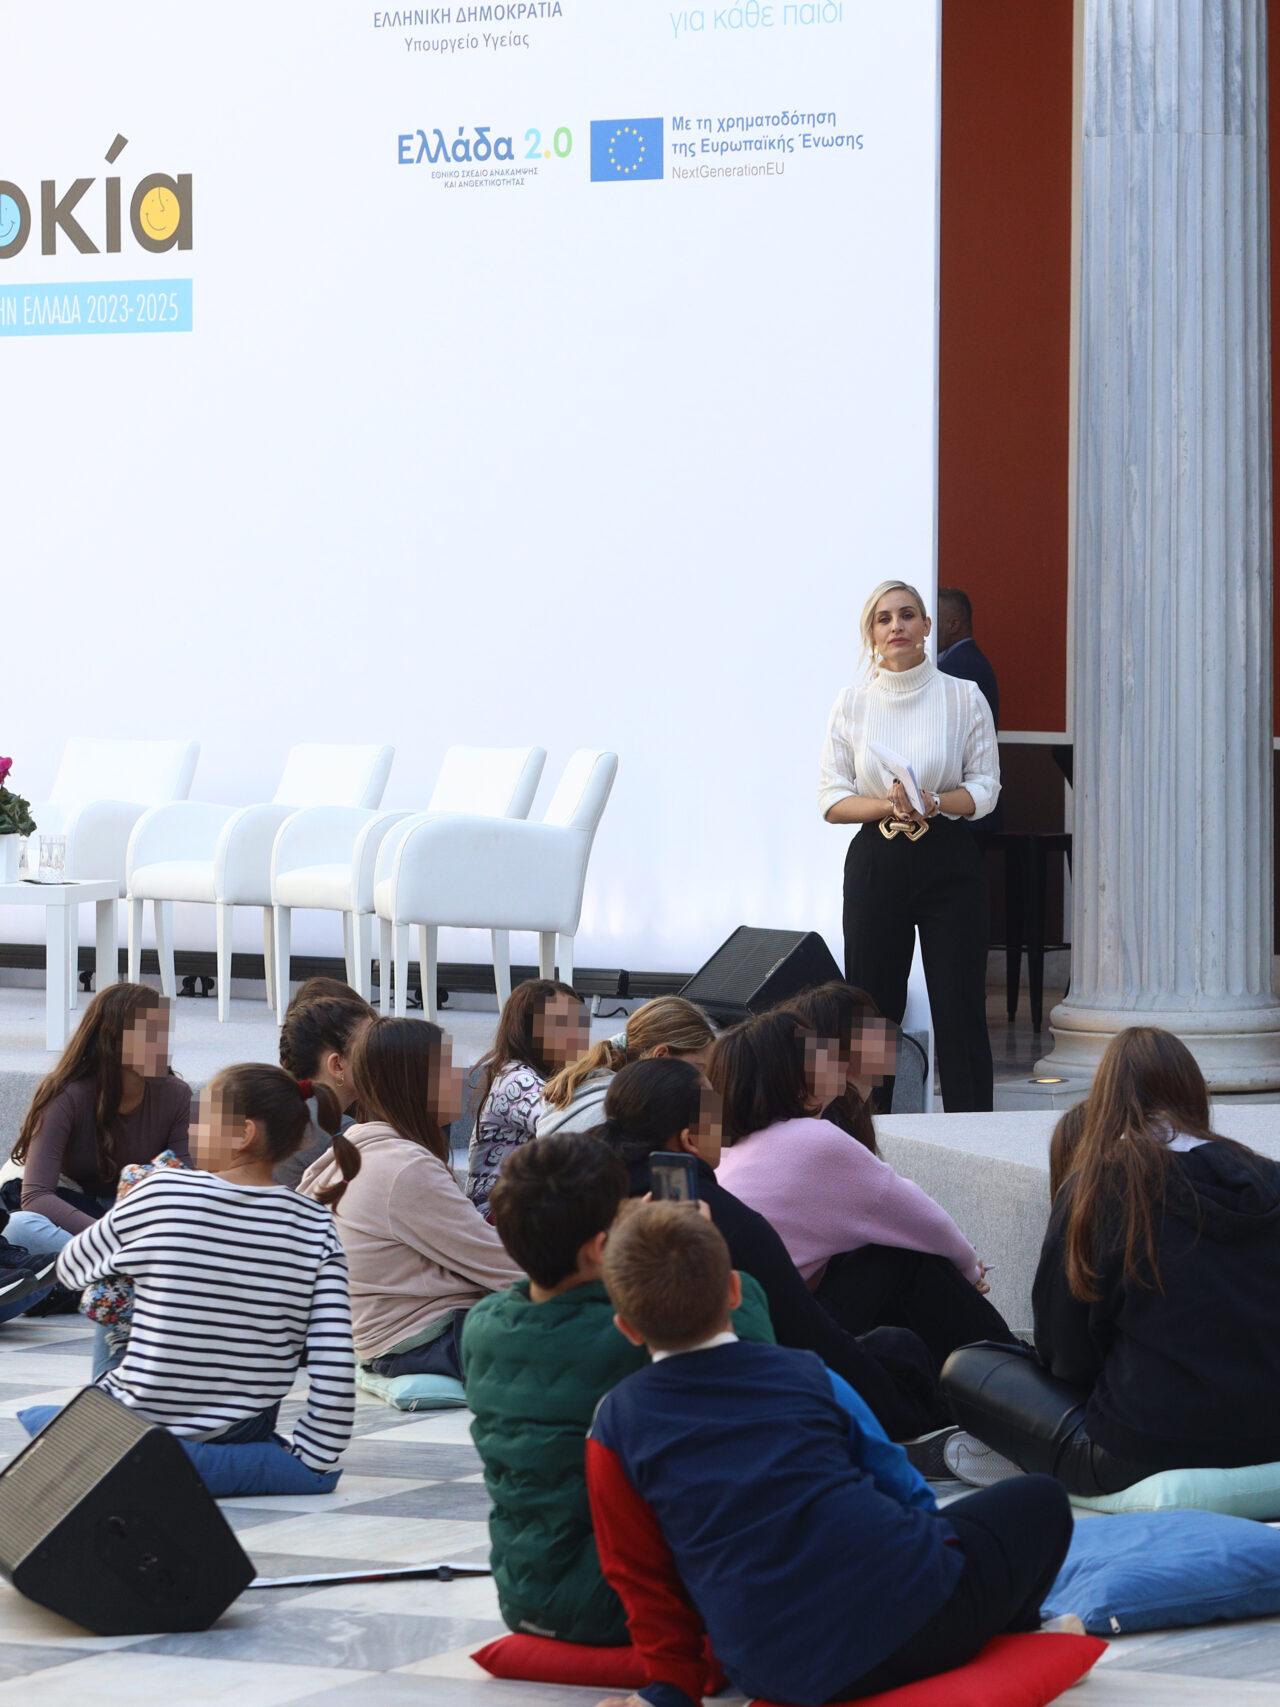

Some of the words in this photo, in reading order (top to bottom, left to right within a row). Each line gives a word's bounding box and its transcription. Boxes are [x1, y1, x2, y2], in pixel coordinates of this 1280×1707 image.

[374, 8, 451, 28] ΕΛΛΗΝΙΚΗ
[456, 1, 563, 23] ΔΗΜΟΚΡΑΤΙΑ
[670, 10, 704, 39] για
[713, 0, 774, 30] κάθε
[404, 33, 478, 54] Υπουργείο
[483, 31, 530, 50] Υγείας
[672, 116, 691, 131] Με
[696, 117, 712, 133] τη
[717, 110, 837, 133] χρηματοδότηση
[398, 126, 515, 164] Ελλάδα
[524, 126, 573, 159] 2.0
[672, 142, 696, 157] της
[701, 135, 794, 156] Ευρωπαϊκής
[798, 133, 864, 150] Ένωσης
[431, 170, 460, 179] ΕΘΝΙΚΟ
[461, 168, 489, 178] ΣΧΕΔΙΟ
[489, 167, 539, 177] ΑΝΑΚΑΜΨΗΣ
[672, 162, 785, 179] NextGenerationEU
[444, 180, 457, 188] ΚΑΙ
[458, 178, 525, 188] ΑΝΘΕΚΤΙΚΟΤΗΤΑΣ
[23, 294, 81, 325] ΕΛΛΑΔΑ
[87, 292, 178, 324] 2023-2025
